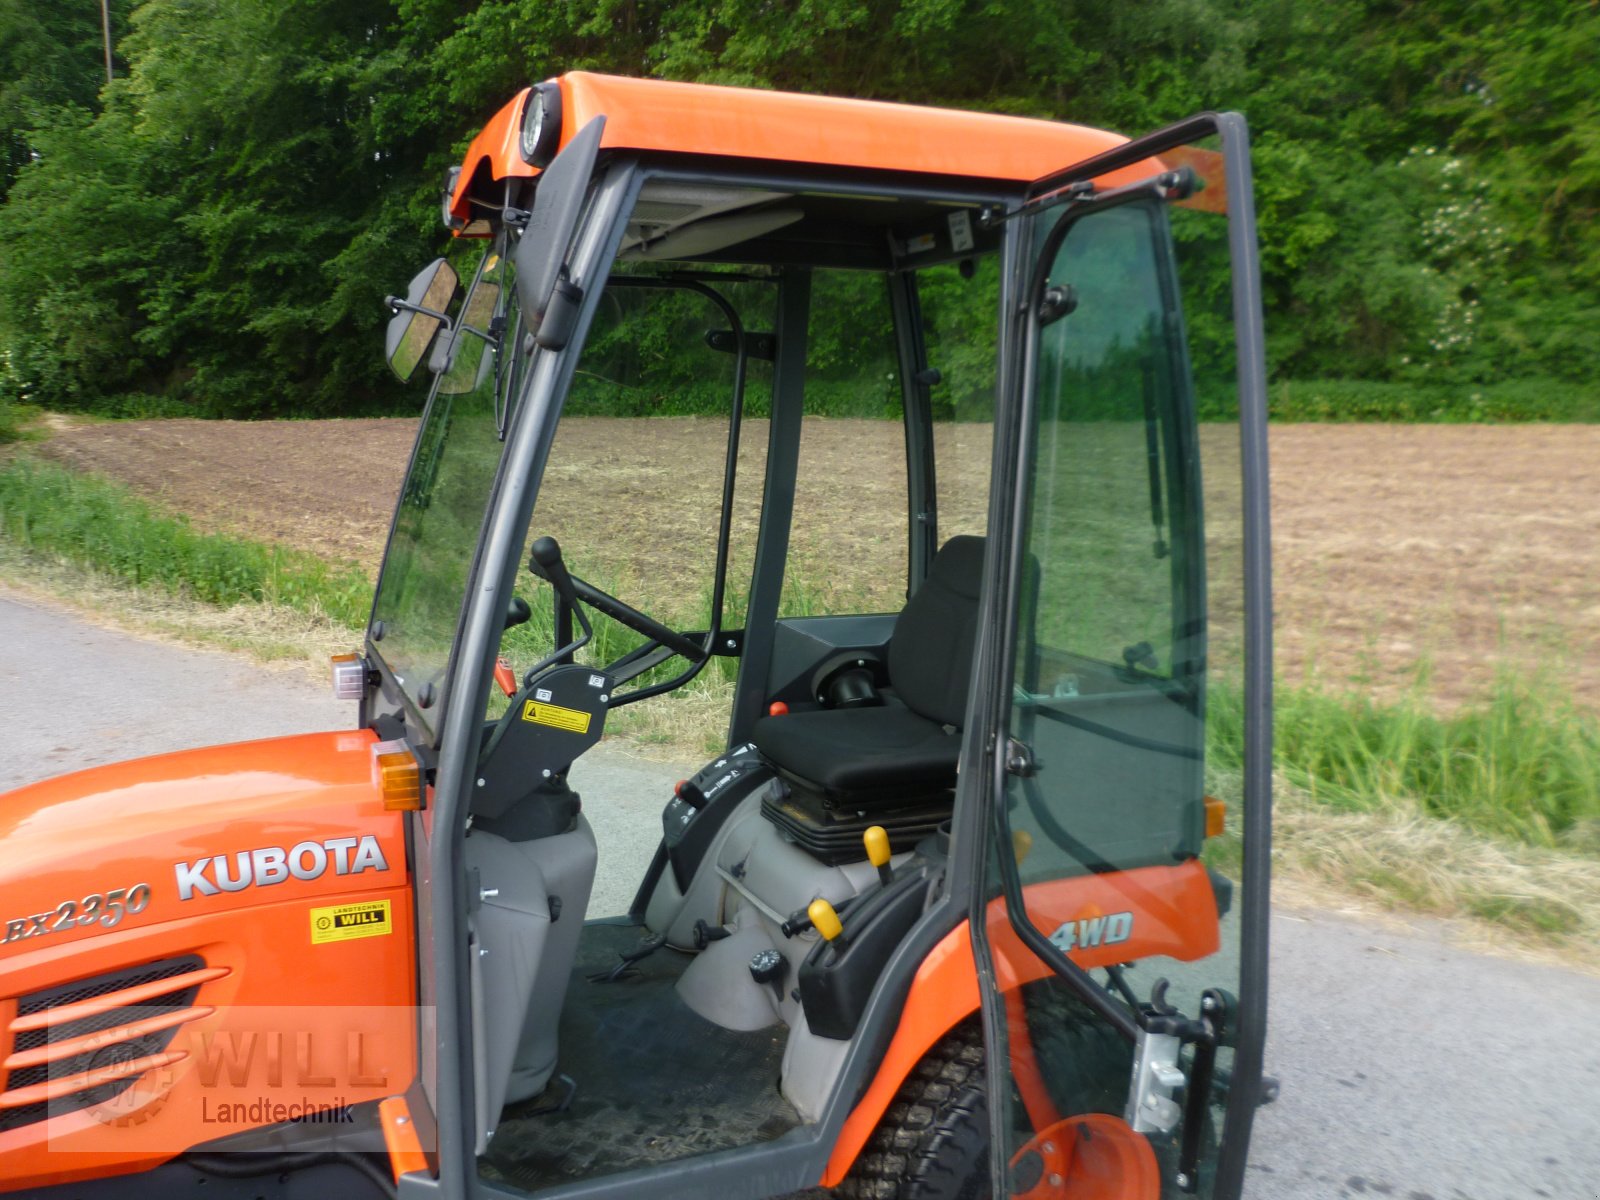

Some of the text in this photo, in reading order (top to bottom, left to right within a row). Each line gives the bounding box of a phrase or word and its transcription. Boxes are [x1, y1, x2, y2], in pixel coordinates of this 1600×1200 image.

[175, 836, 389, 901] KUBOTA
[0, 883, 151, 943] BX2350
[333, 904, 385, 914] LANDTECHNIK
[340, 911, 379, 926] WILL
[1048, 911, 1133, 951] 4WD
